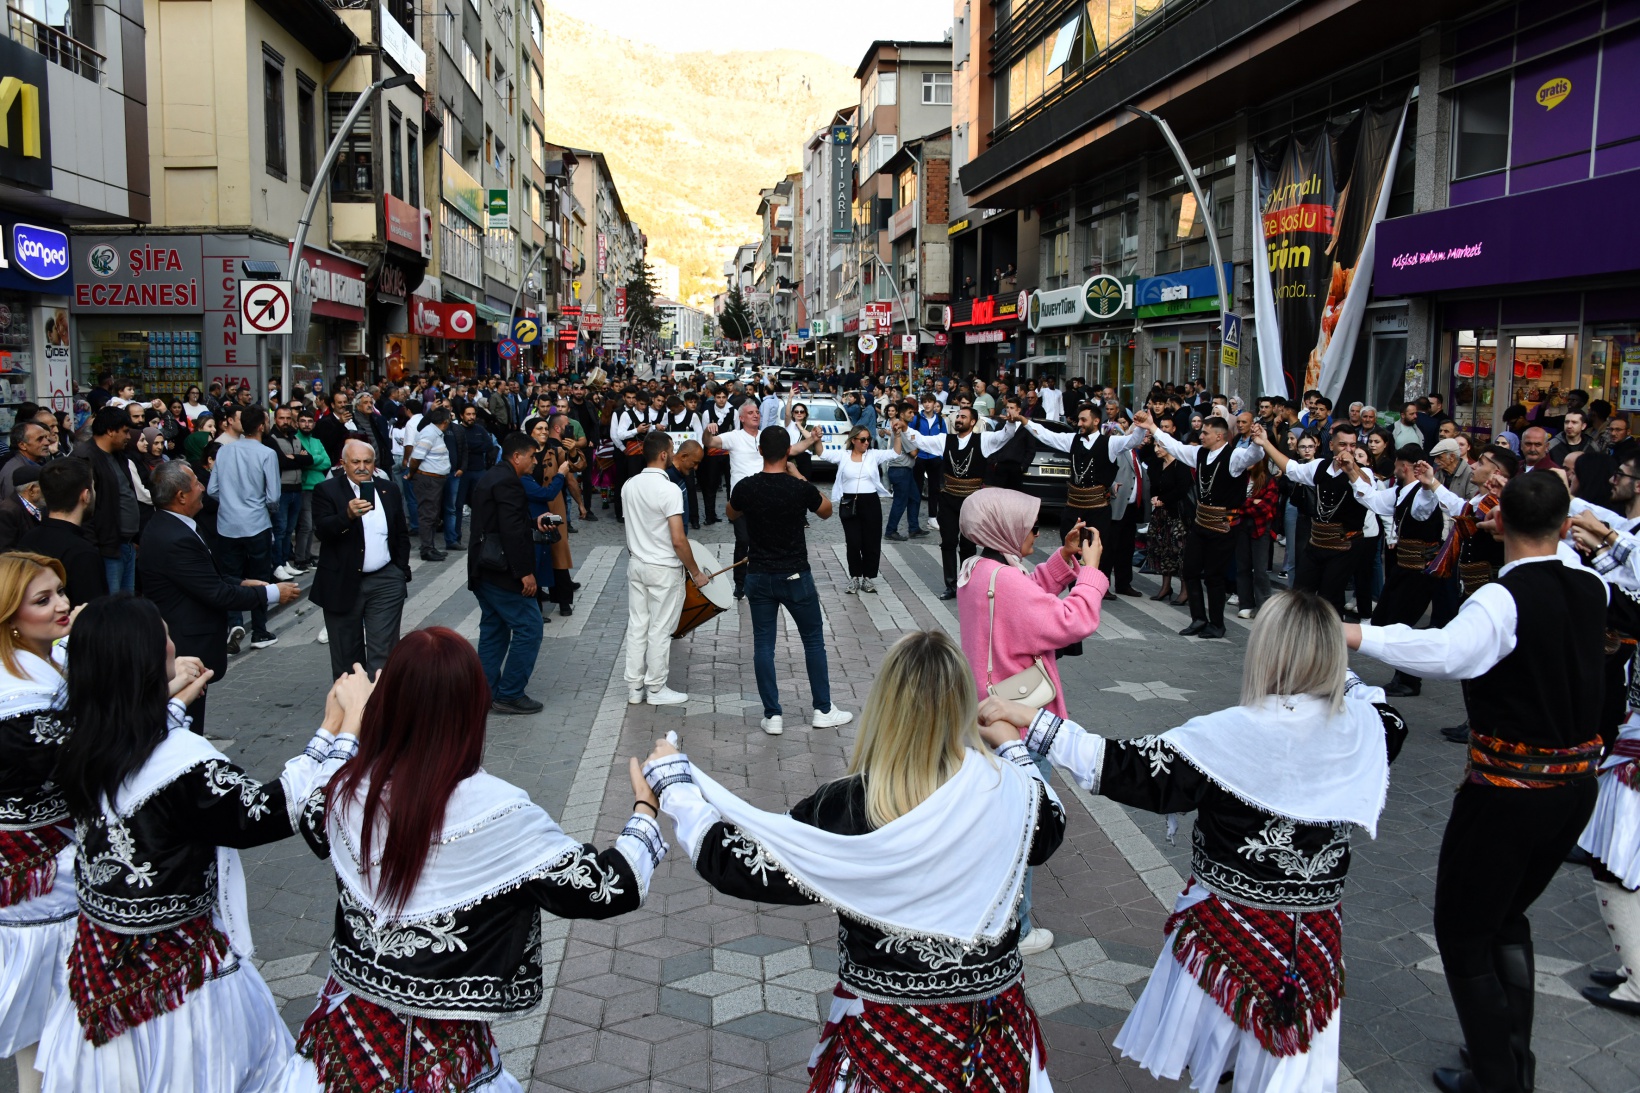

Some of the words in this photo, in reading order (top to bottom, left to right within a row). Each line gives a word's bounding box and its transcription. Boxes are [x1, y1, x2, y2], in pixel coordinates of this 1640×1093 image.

[1539, 80, 1568, 103] gratis
[1280, 207, 1317, 232] soslu
[23, 240, 67, 267] canped
[128, 243, 183, 277] ŞİFA
[75, 278, 198, 307] ECZANESİ
[222, 259, 237, 364] ECZANE
